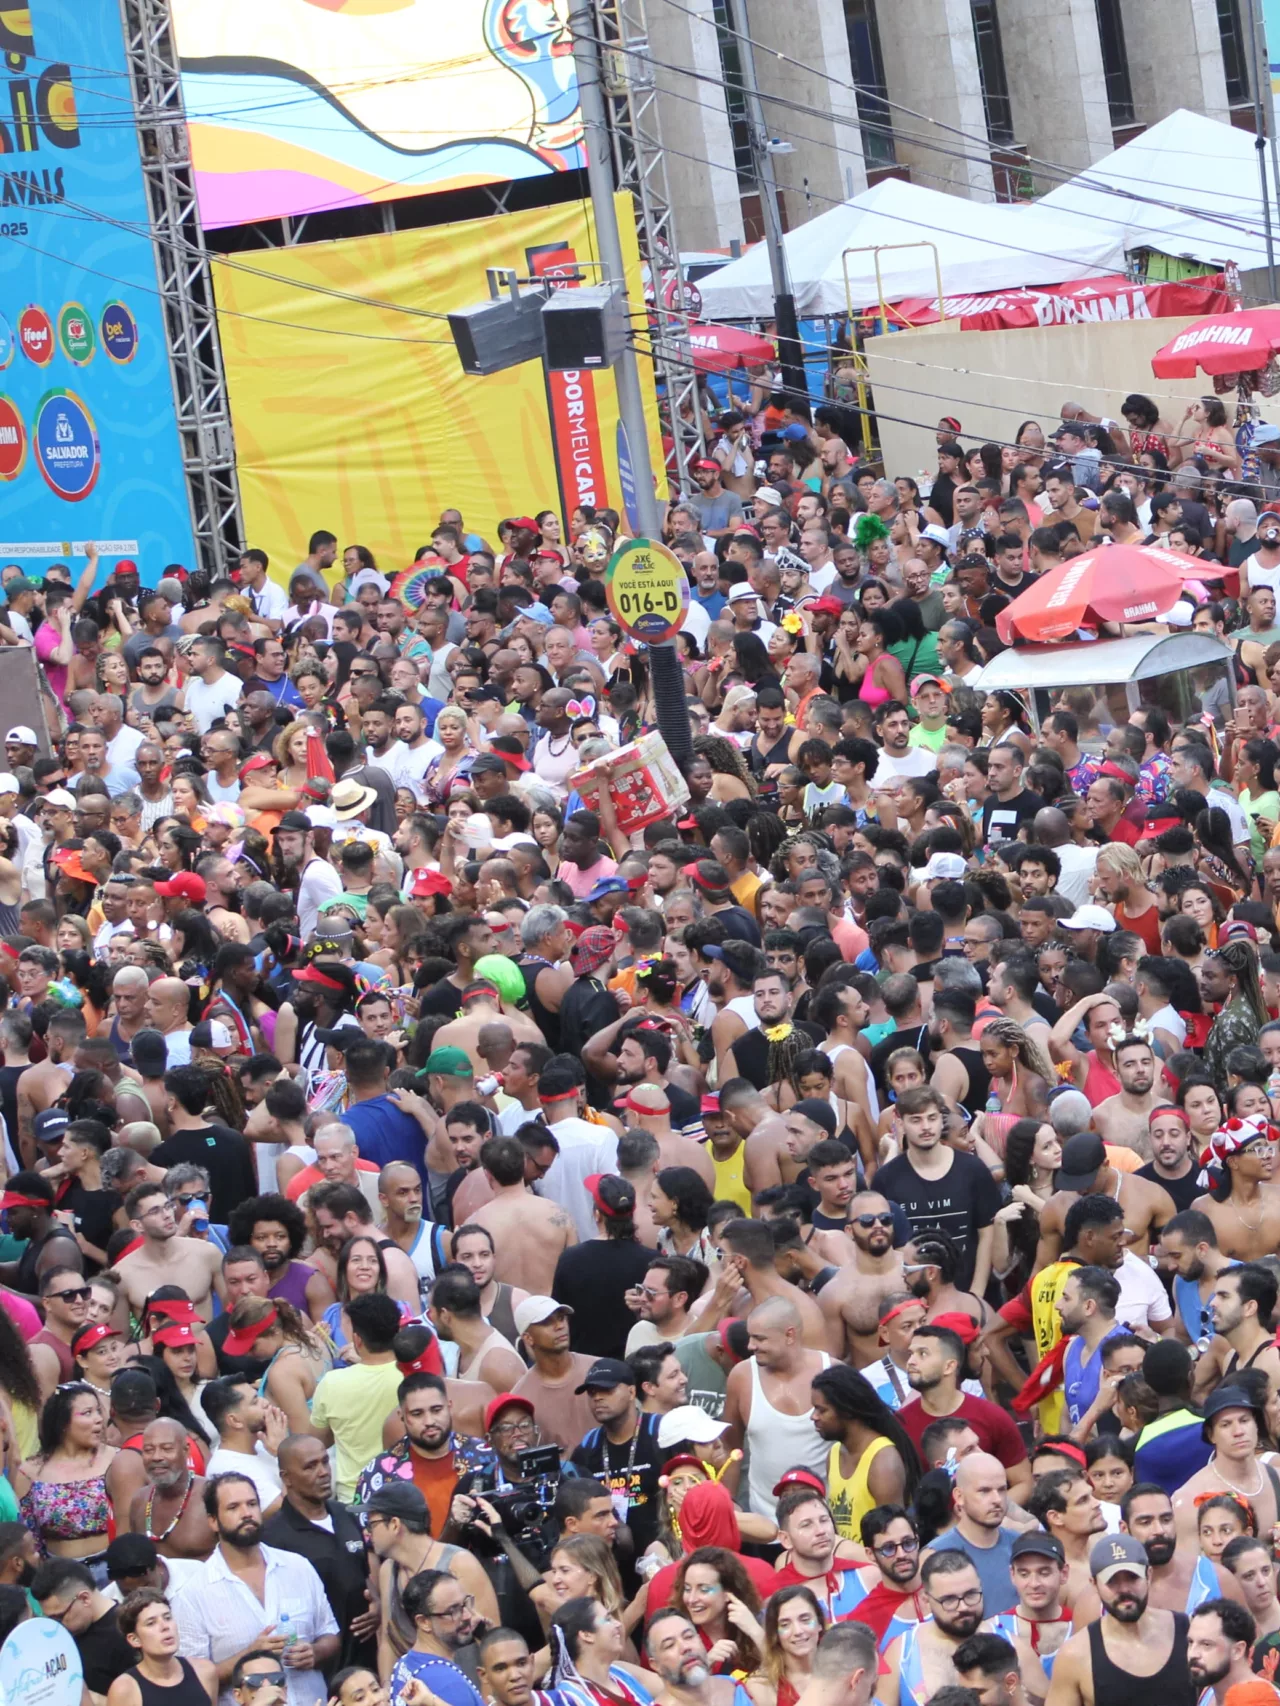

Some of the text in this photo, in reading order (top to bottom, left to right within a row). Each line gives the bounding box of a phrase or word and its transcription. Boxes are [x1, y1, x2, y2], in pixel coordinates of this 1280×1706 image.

[106, 321, 124, 337] bet
[1171, 325, 1253, 354] BRAHMA
[46, 446, 89, 460] SALVADOR
[619, 579, 674, 589] VOCÊ ESTÁ AQUI
[1046, 558, 1096, 609] BRAHMA
[620, 591, 678, 614] 016-D
[1123, 601, 1158, 619] BRAHMA
[928, 1198, 951, 1209] VIM
[1110, 1542, 1127, 1560] LA
